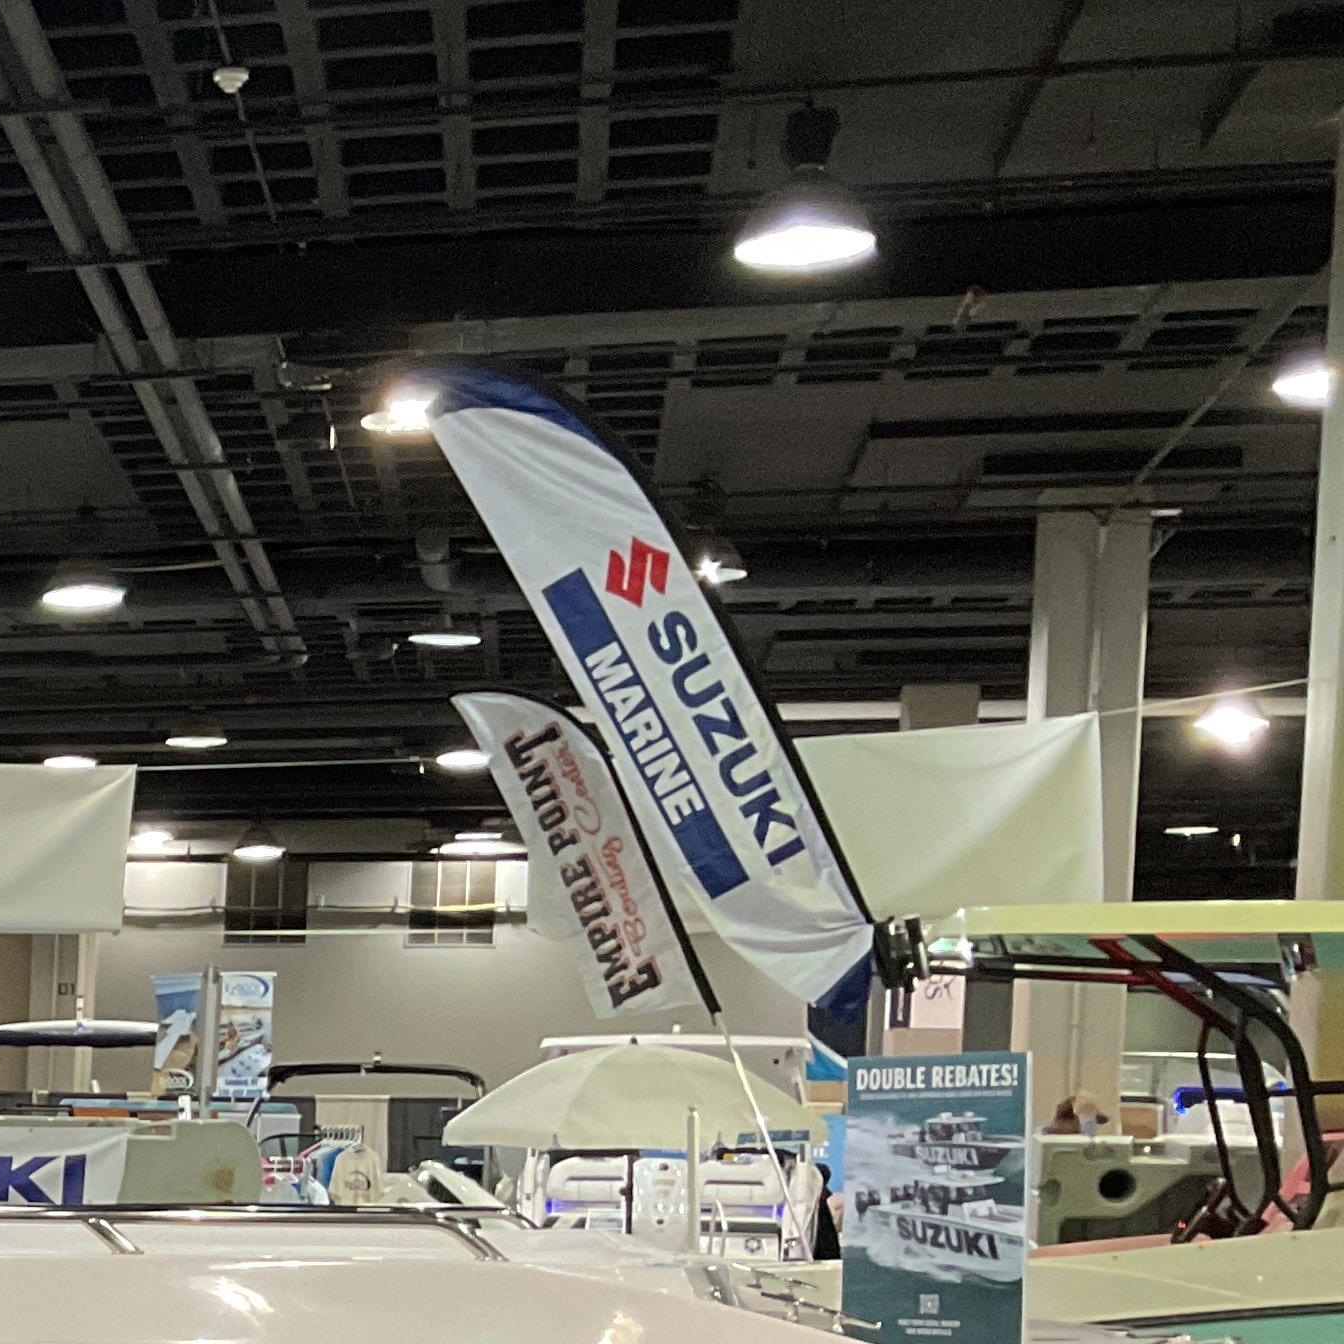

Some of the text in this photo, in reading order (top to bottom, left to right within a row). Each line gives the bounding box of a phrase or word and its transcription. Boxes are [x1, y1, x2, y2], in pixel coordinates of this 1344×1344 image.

[584, 641, 705, 826] MARINE
[648, 611, 805, 867] SUZUKI
[504, 720, 662, 1009] EMPIRE POINT
[855, 1063, 1019, 1091] DOUBLE REBATES!
[895, 1216, 1002, 1260] SUZUKI
